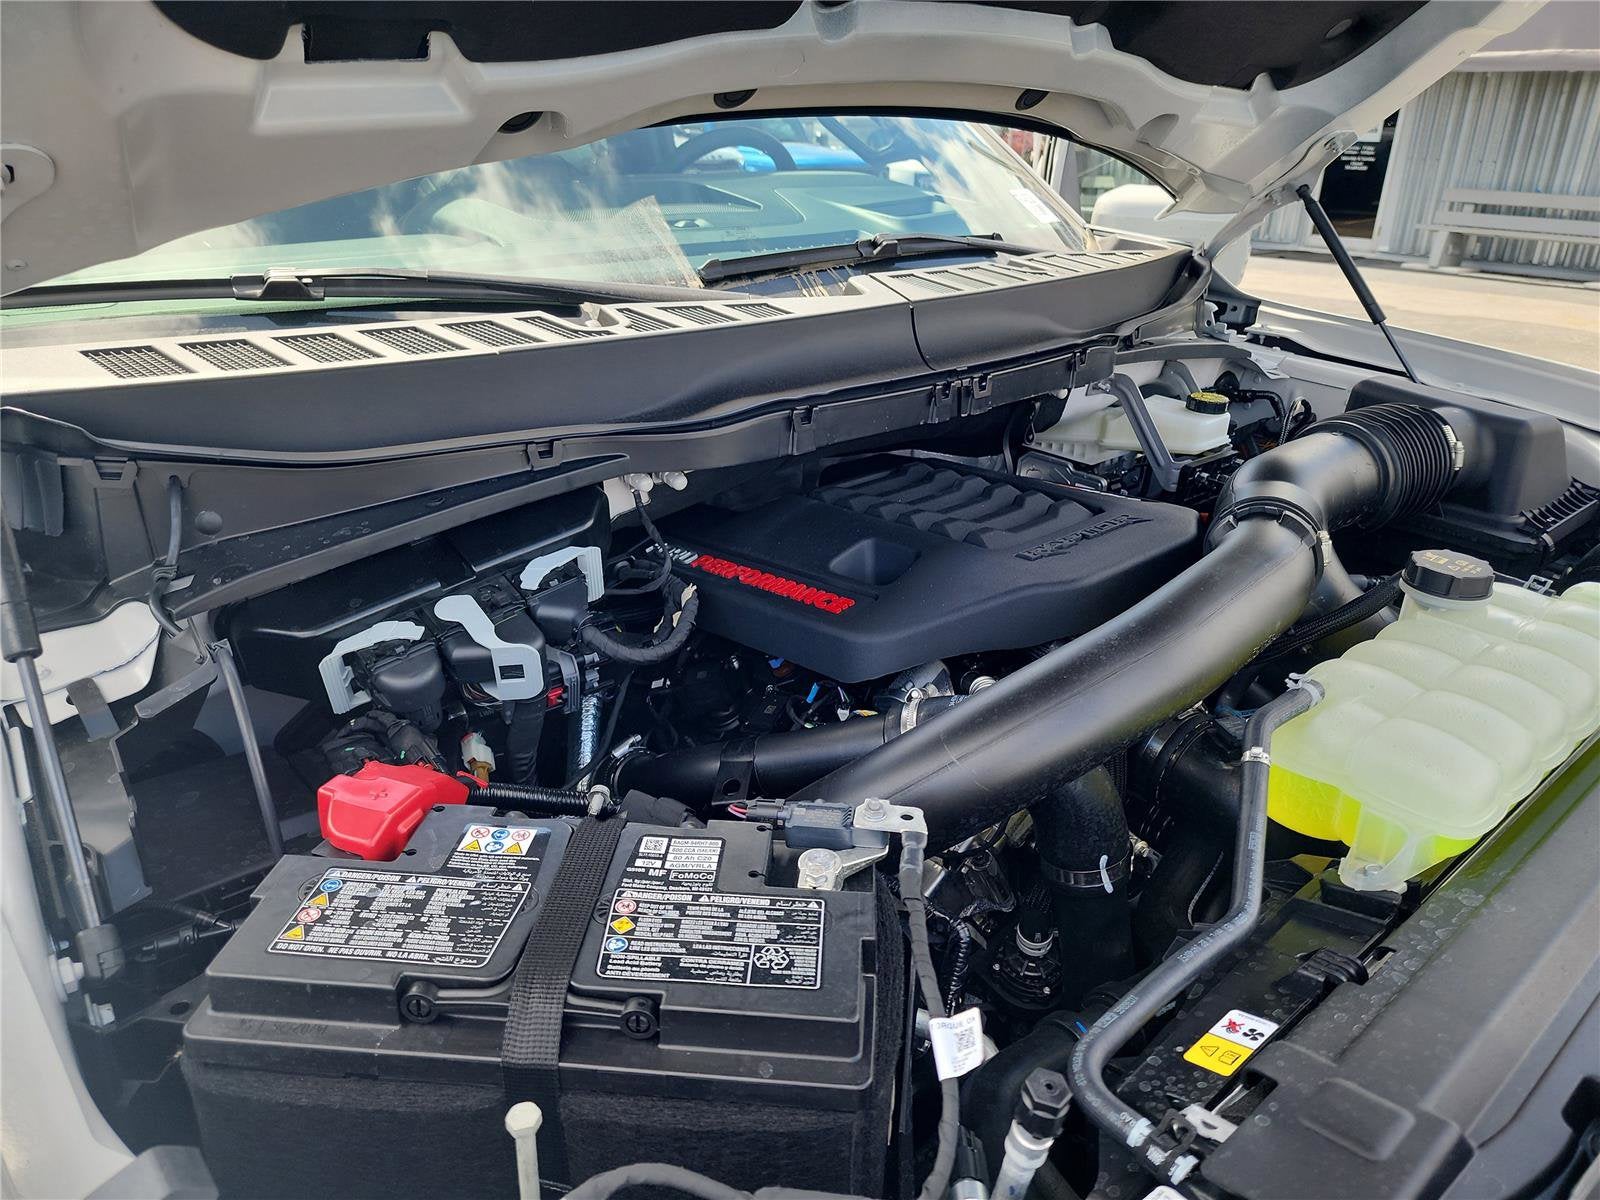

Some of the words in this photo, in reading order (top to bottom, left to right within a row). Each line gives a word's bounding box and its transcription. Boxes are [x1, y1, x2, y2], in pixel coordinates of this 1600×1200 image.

[690, 554, 855, 615] PERFORMANCE
[670, 862, 713, 870] AGM/VRLA
[648, 869, 668, 877] MF
[671, 871, 714, 882] FoMoCo
[341, 872, 401, 881] DANGER/POISON
[417, 877, 476, 887] PELIGRO/VENENO
[631, 891, 692, 901] DANGER/POISON
[710, 896, 770, 906] PELIGRO/VENENO
[303, 945, 326, 953] OPEN.
[354, 949, 383, 957] OUVRIR.
